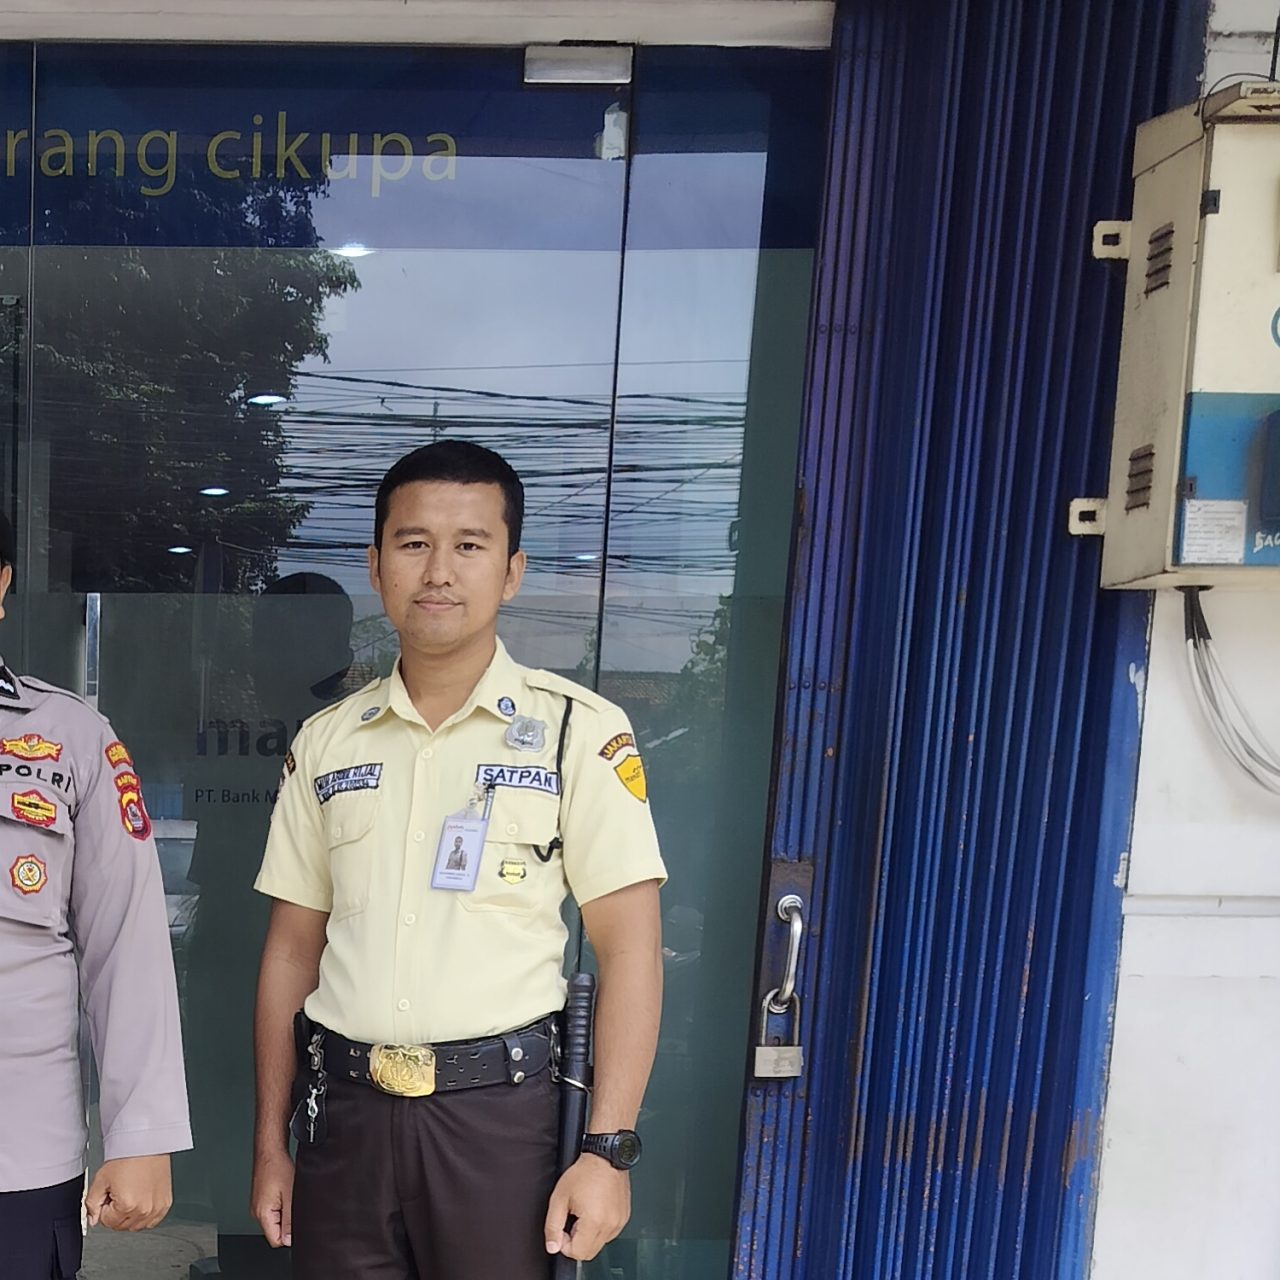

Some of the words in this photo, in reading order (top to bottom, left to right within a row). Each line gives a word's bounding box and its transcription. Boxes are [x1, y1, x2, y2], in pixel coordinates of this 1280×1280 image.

[206, 110, 458, 198] cikupa
[195, 789, 217, 804] PT.
[223, 788, 261, 804] Bank
